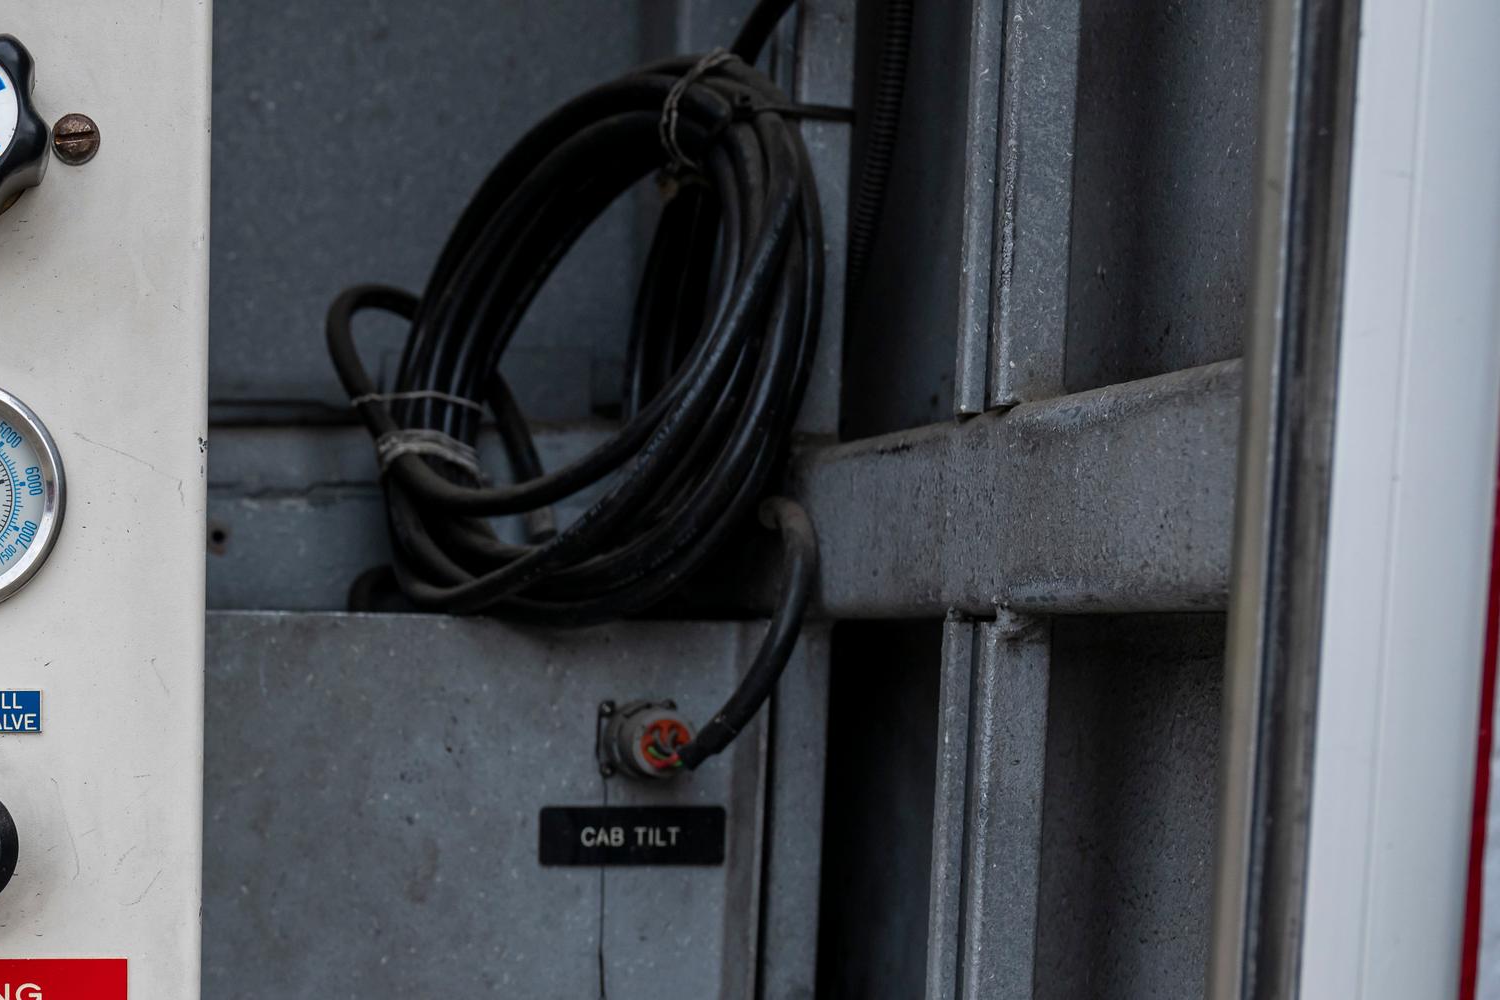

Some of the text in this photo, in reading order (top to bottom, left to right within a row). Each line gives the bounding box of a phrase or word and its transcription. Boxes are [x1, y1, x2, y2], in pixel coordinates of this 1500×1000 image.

[25, 466, 43, 496] 6000
[15, 520, 38, 550] 7000
[580, 826, 680, 847] CAB TILT
